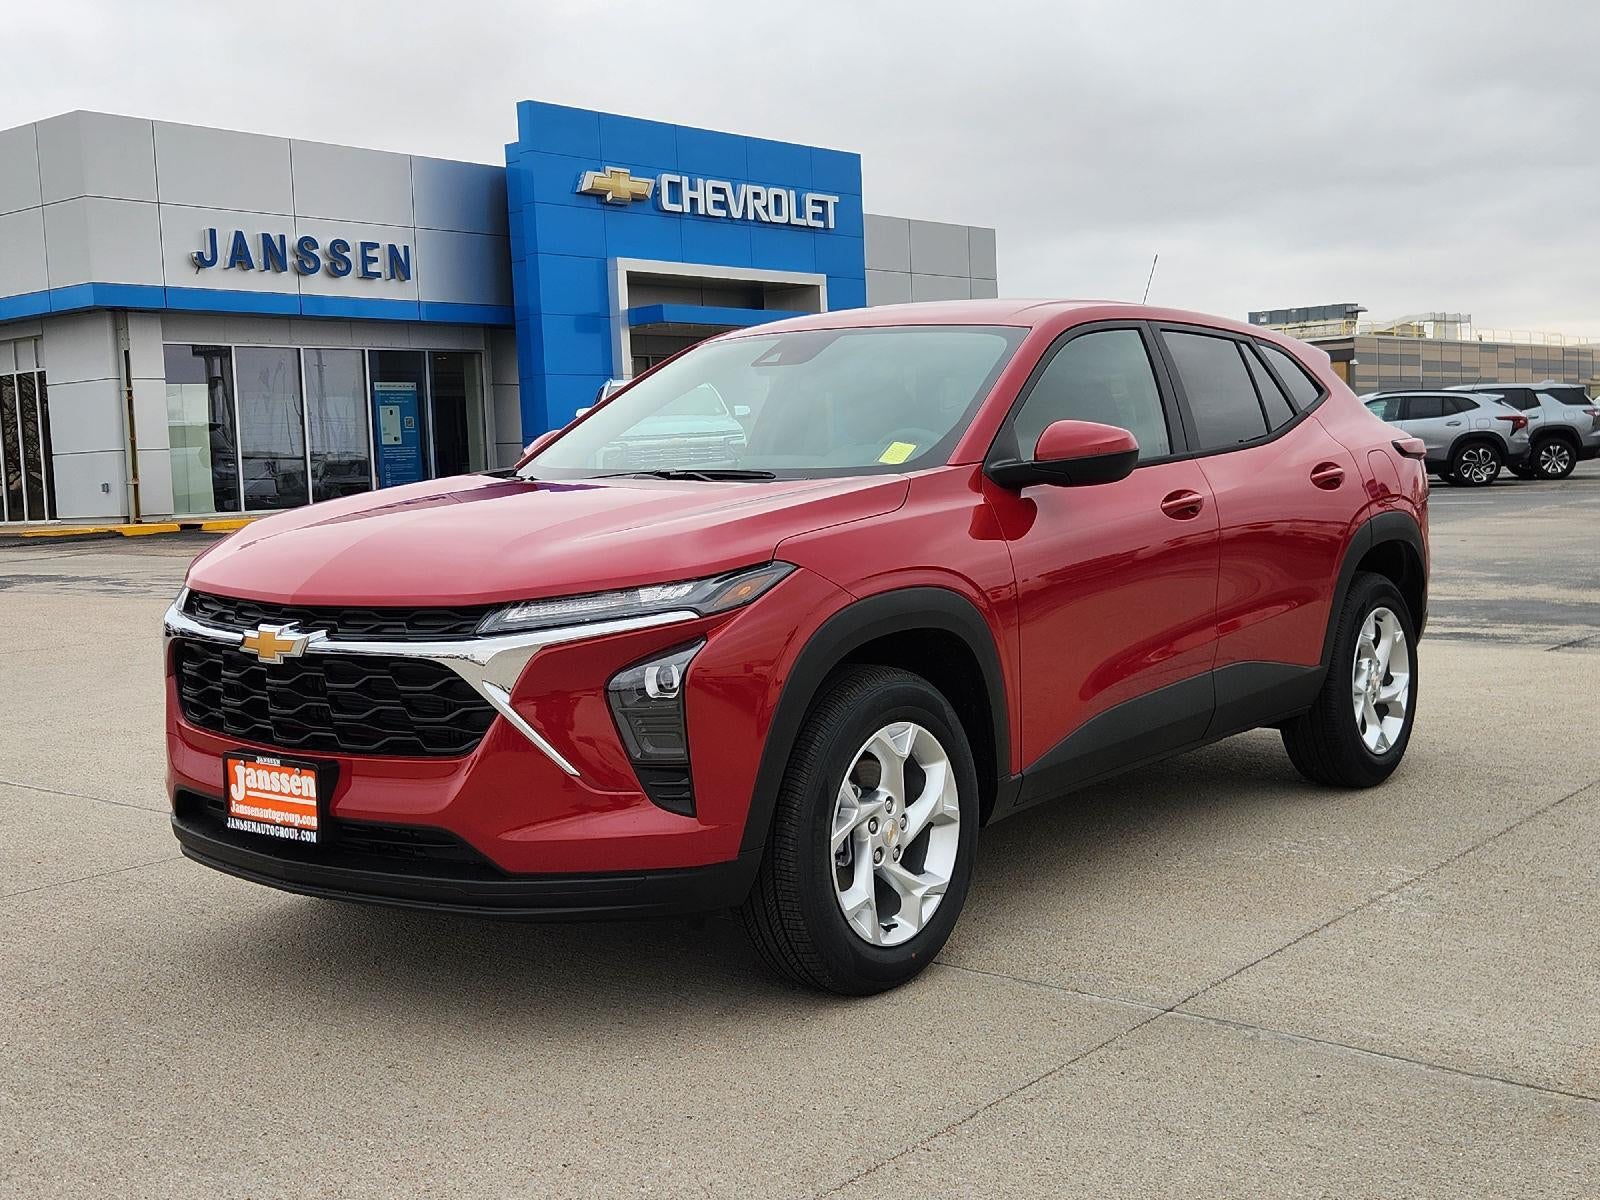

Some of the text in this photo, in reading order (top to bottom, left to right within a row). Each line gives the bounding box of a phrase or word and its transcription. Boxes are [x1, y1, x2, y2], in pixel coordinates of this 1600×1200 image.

[657, 173, 840, 229] CHEVROLET
[191, 227, 412, 281] JANSSEN
[230, 764, 317, 801] Janssen
[226, 816, 317, 843] JANSSENAUTOGROUP.COM
[230, 800, 318, 827] Janssenautogroup.com
